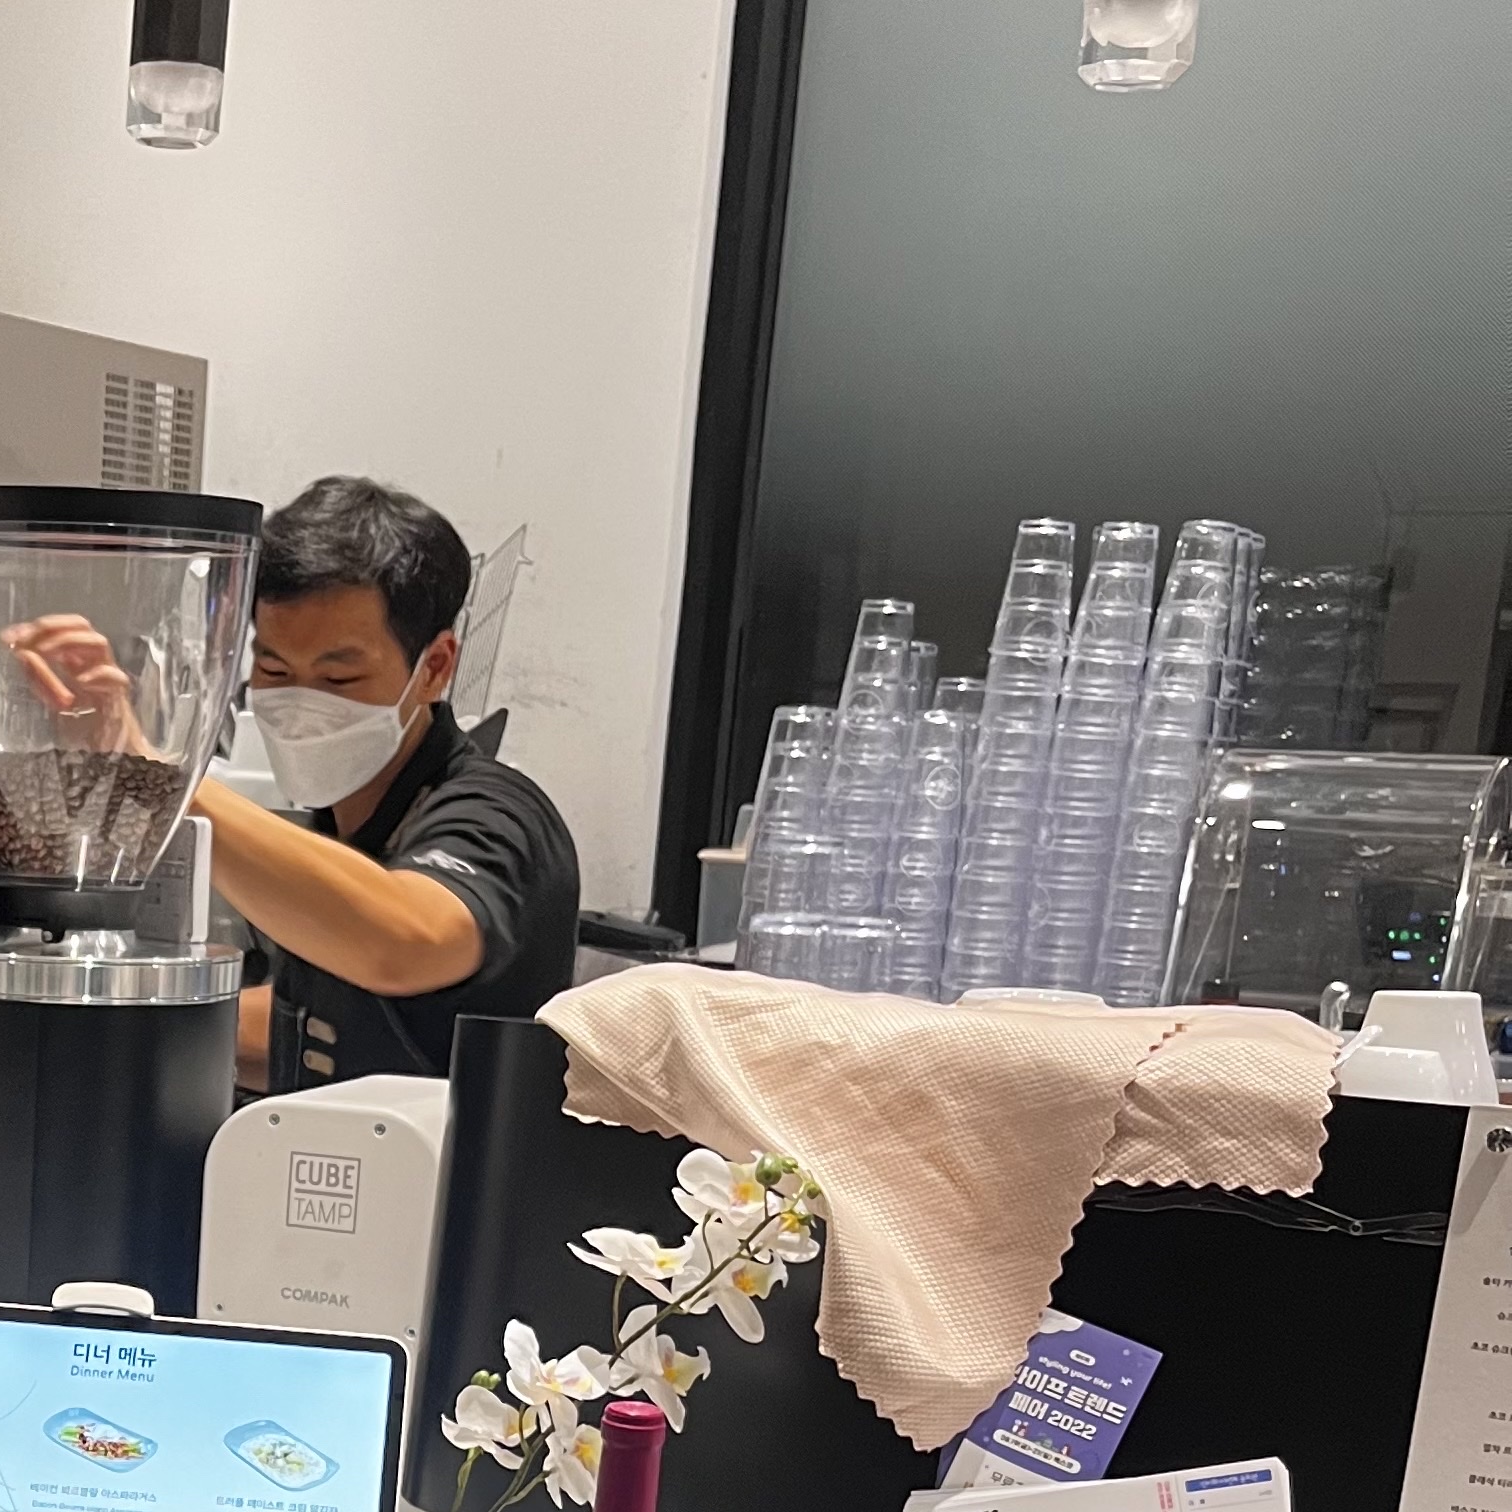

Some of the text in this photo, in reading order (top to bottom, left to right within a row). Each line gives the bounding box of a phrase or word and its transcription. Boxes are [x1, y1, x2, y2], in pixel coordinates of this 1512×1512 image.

[294, 1159, 356, 1190] CUBE
[293, 1197, 353, 1225] TAMP
[280, 1286, 350, 1309] COMPAK
[73, 1343, 158, 1368] 디너 메뉴
[70, 1365, 155, 1383] Dinner Menu
[1008, 1391, 1097, 1441] 페어 2022
[101, 1488, 157, 1502] 아스파라거스
